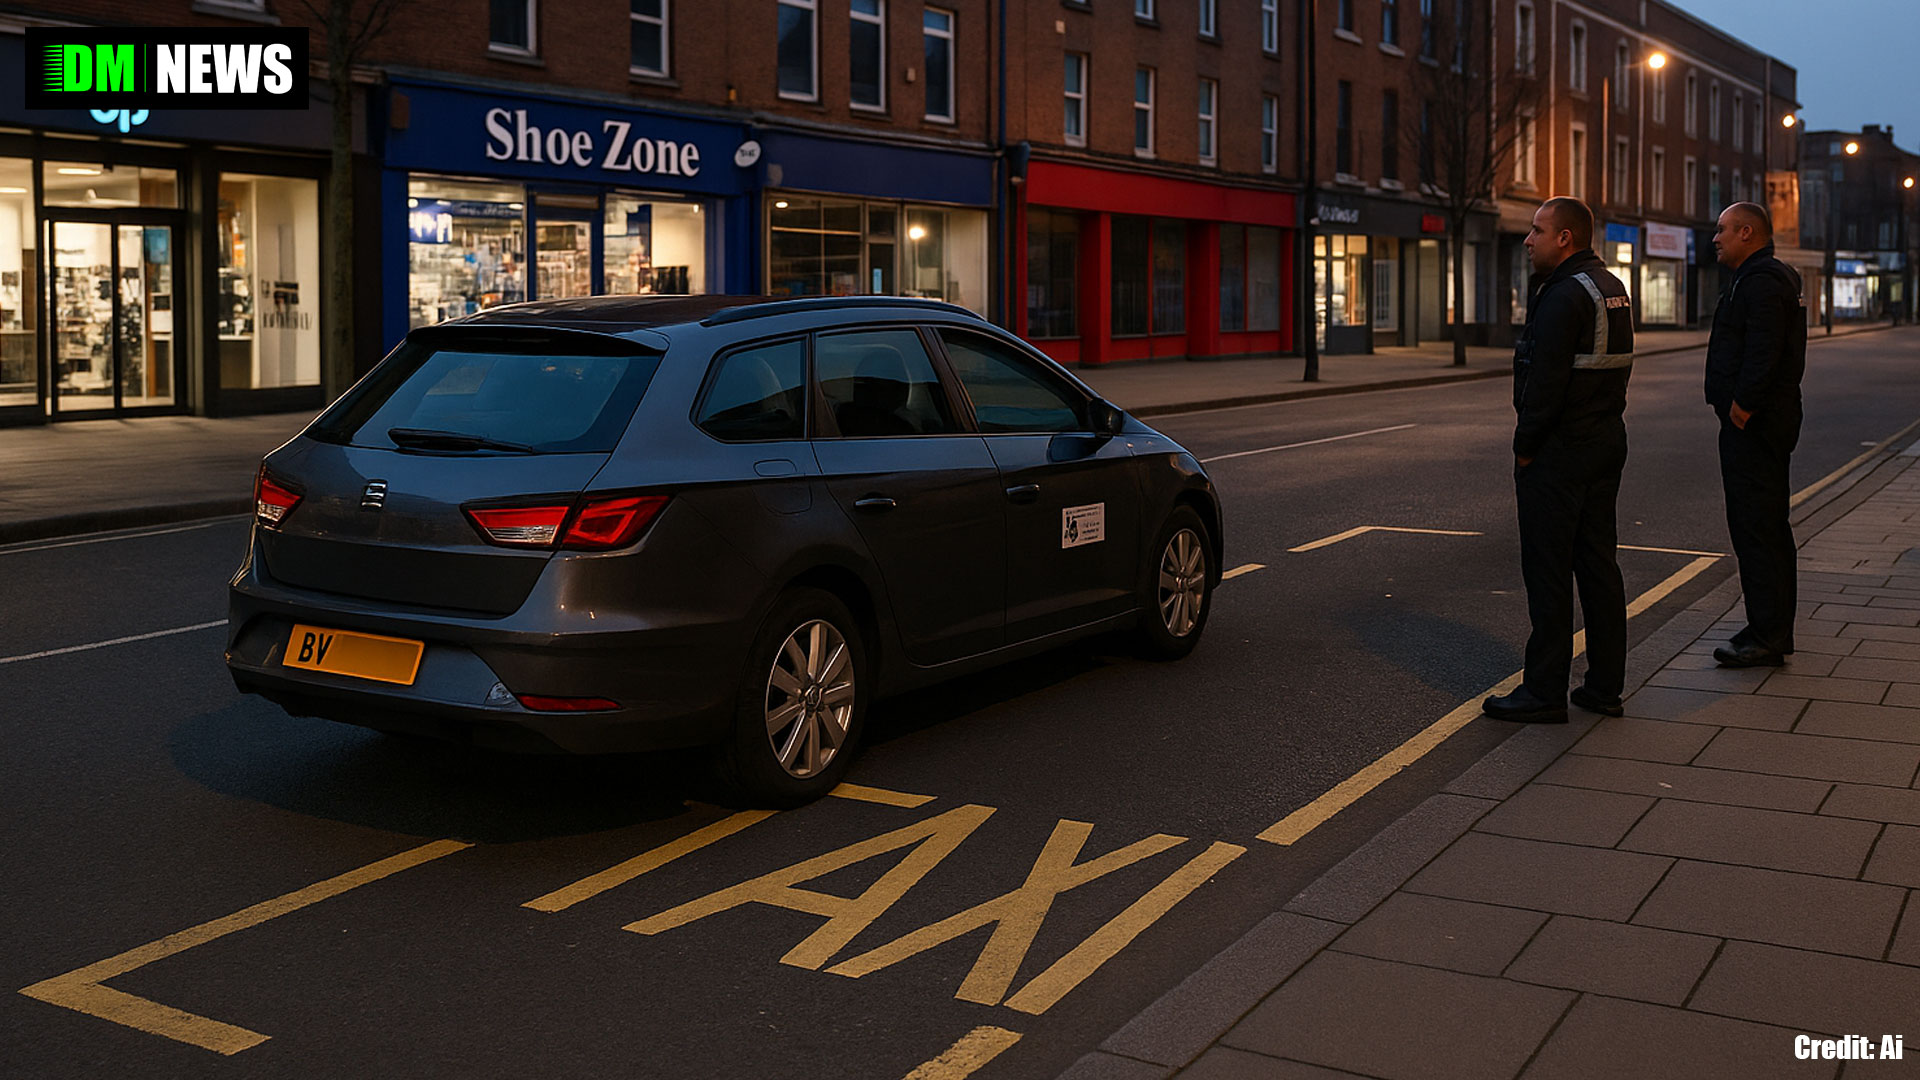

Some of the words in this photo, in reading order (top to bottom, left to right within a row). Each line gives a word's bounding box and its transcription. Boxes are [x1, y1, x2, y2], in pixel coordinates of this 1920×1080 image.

[485, 107, 593, 168] Shoe
[601, 119, 700, 177] Zone
[298, 632, 333, 665] BV
[520, 783, 1248, 1016] TAXI
